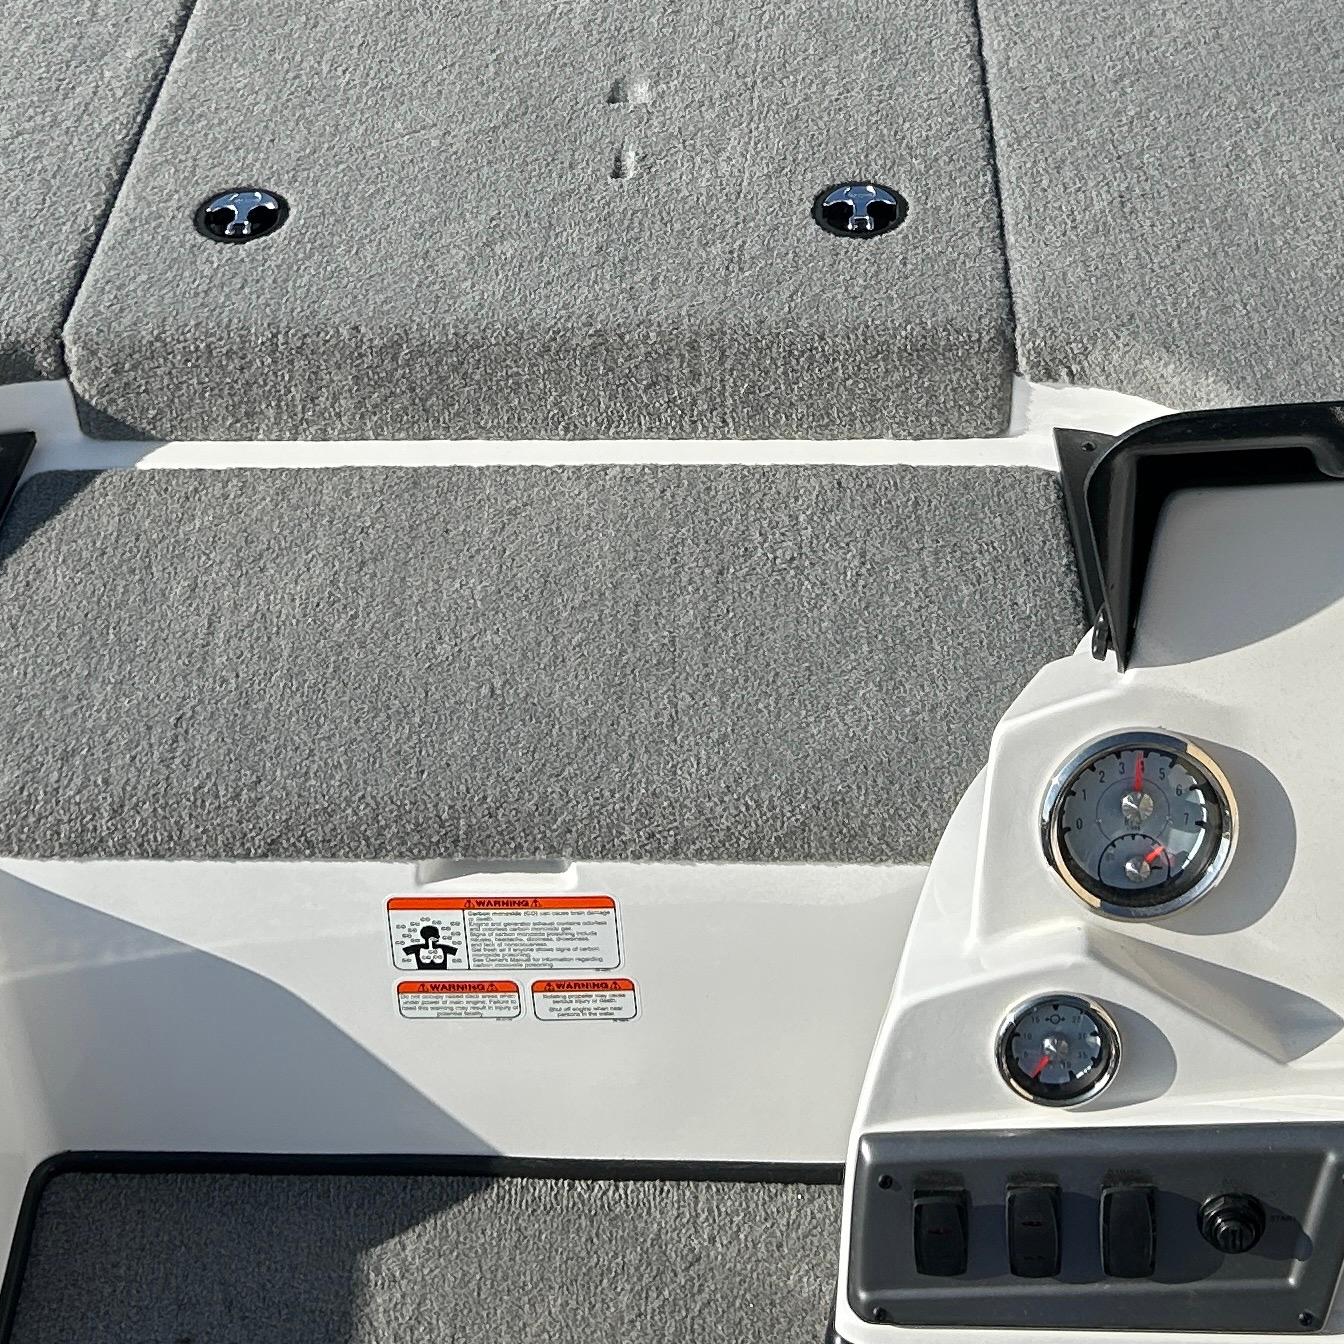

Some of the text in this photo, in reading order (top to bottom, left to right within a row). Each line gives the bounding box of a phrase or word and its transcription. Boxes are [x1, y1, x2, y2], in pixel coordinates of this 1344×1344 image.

[1119, 762, 1125, 774] 3
[1159, 768, 1165, 780] 5
[1098, 771, 1105, 783] 2
[1082, 789, 1087, 801] 1
[1176, 785, 1182, 797] 6
[1076, 817, 1083, 830] 0
[1183, 813, 1189, 825] 7
[430, 983, 485, 991] WARNING
